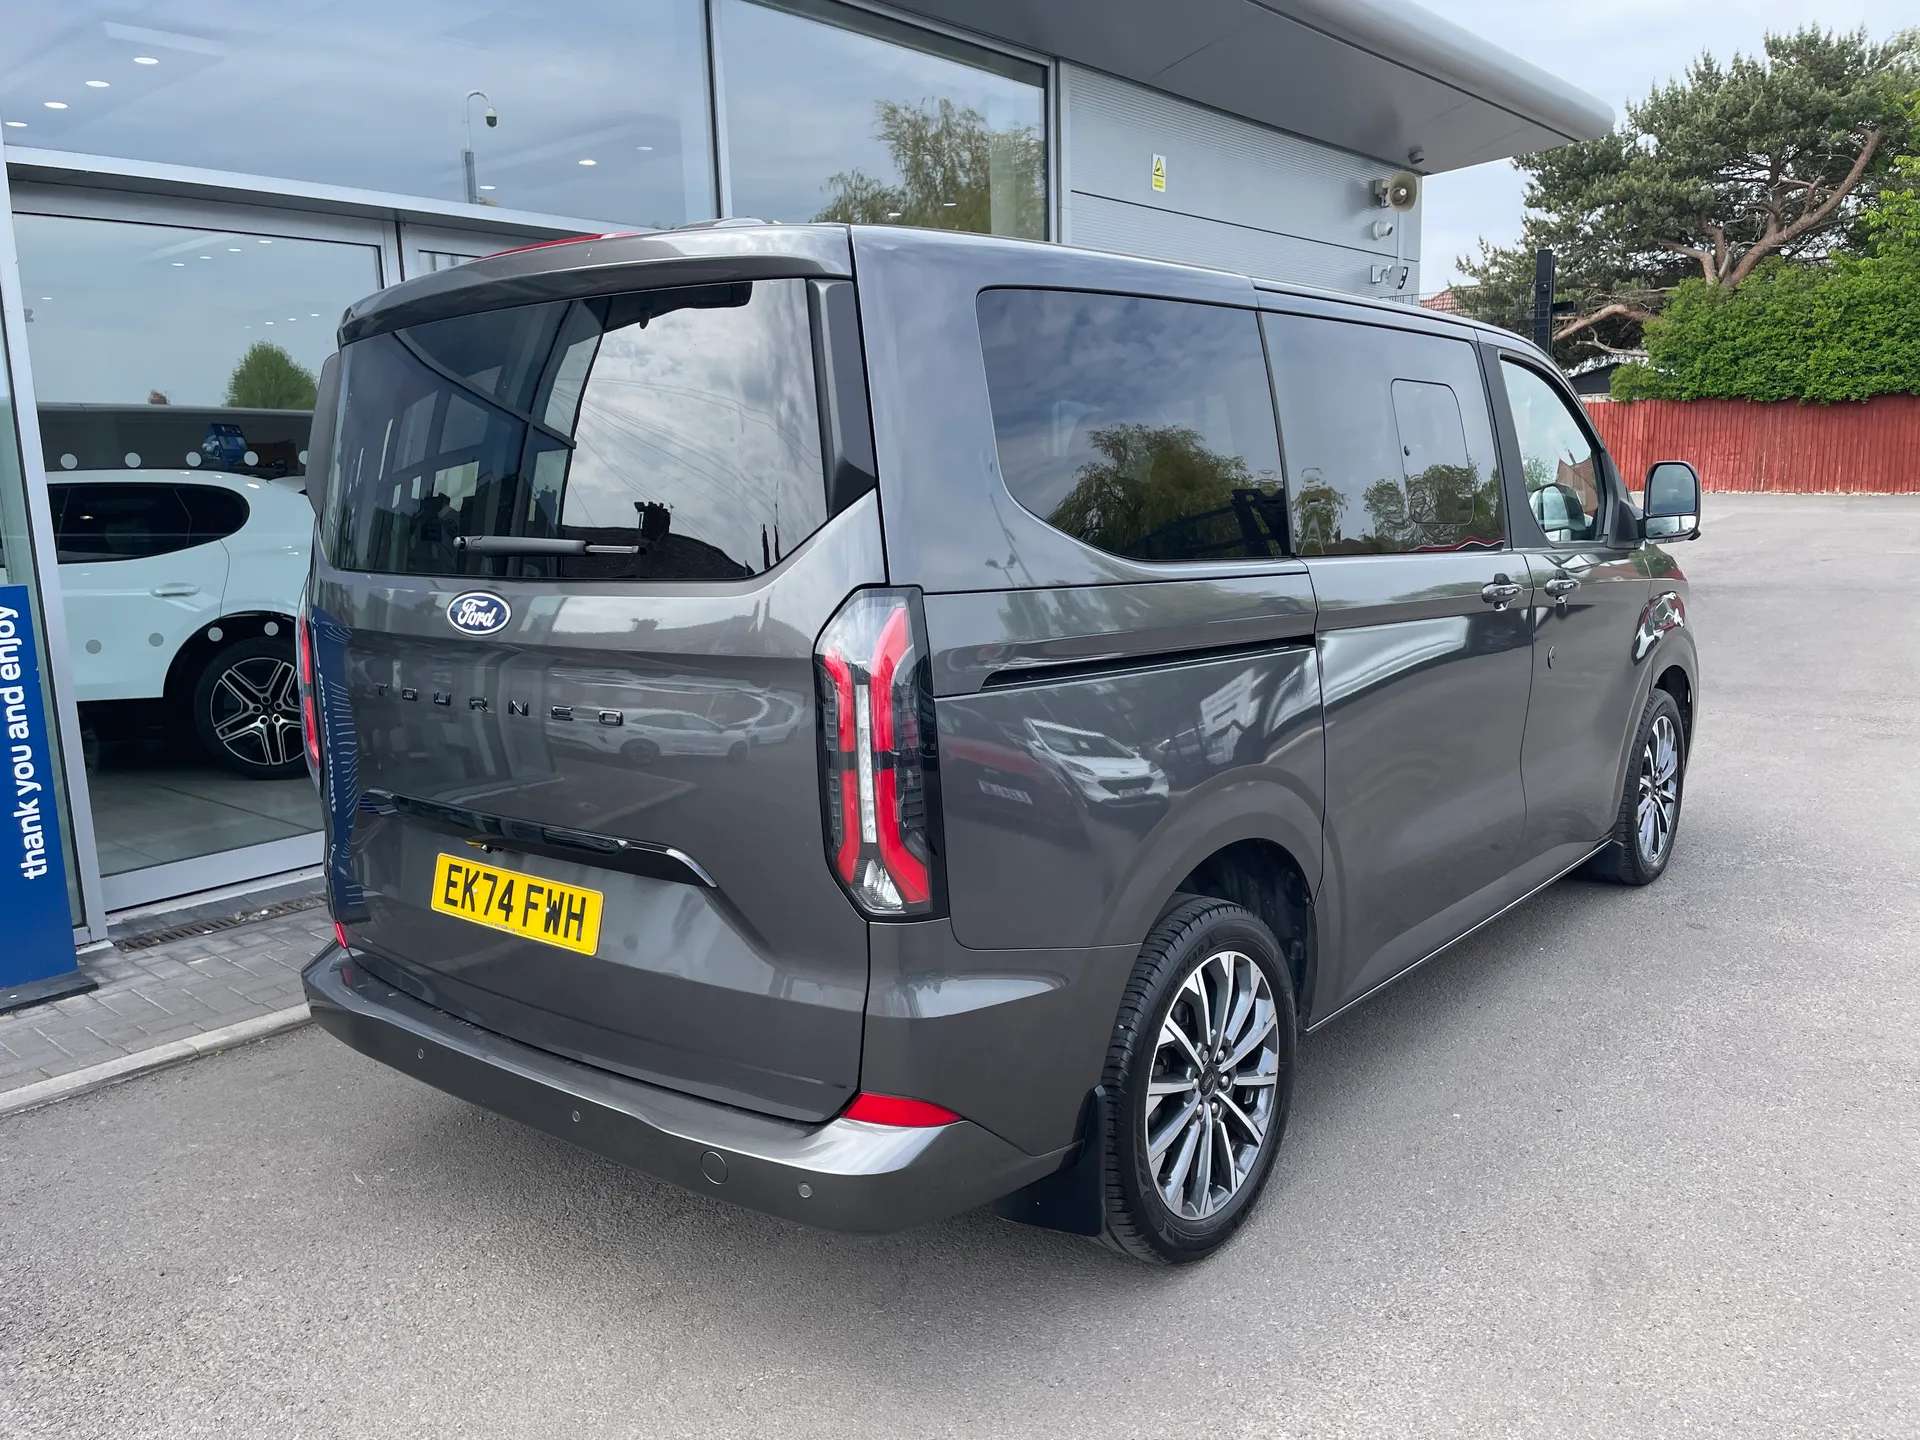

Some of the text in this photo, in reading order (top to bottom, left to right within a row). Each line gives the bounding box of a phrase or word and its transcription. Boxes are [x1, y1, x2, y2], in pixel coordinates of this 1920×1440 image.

[457, 598, 498, 628] Ford
[375, 682, 624, 727] TOURNEO
[0, 605, 47, 880] thank you and enjoy
[443, 863, 587, 942] EK74 FWH
